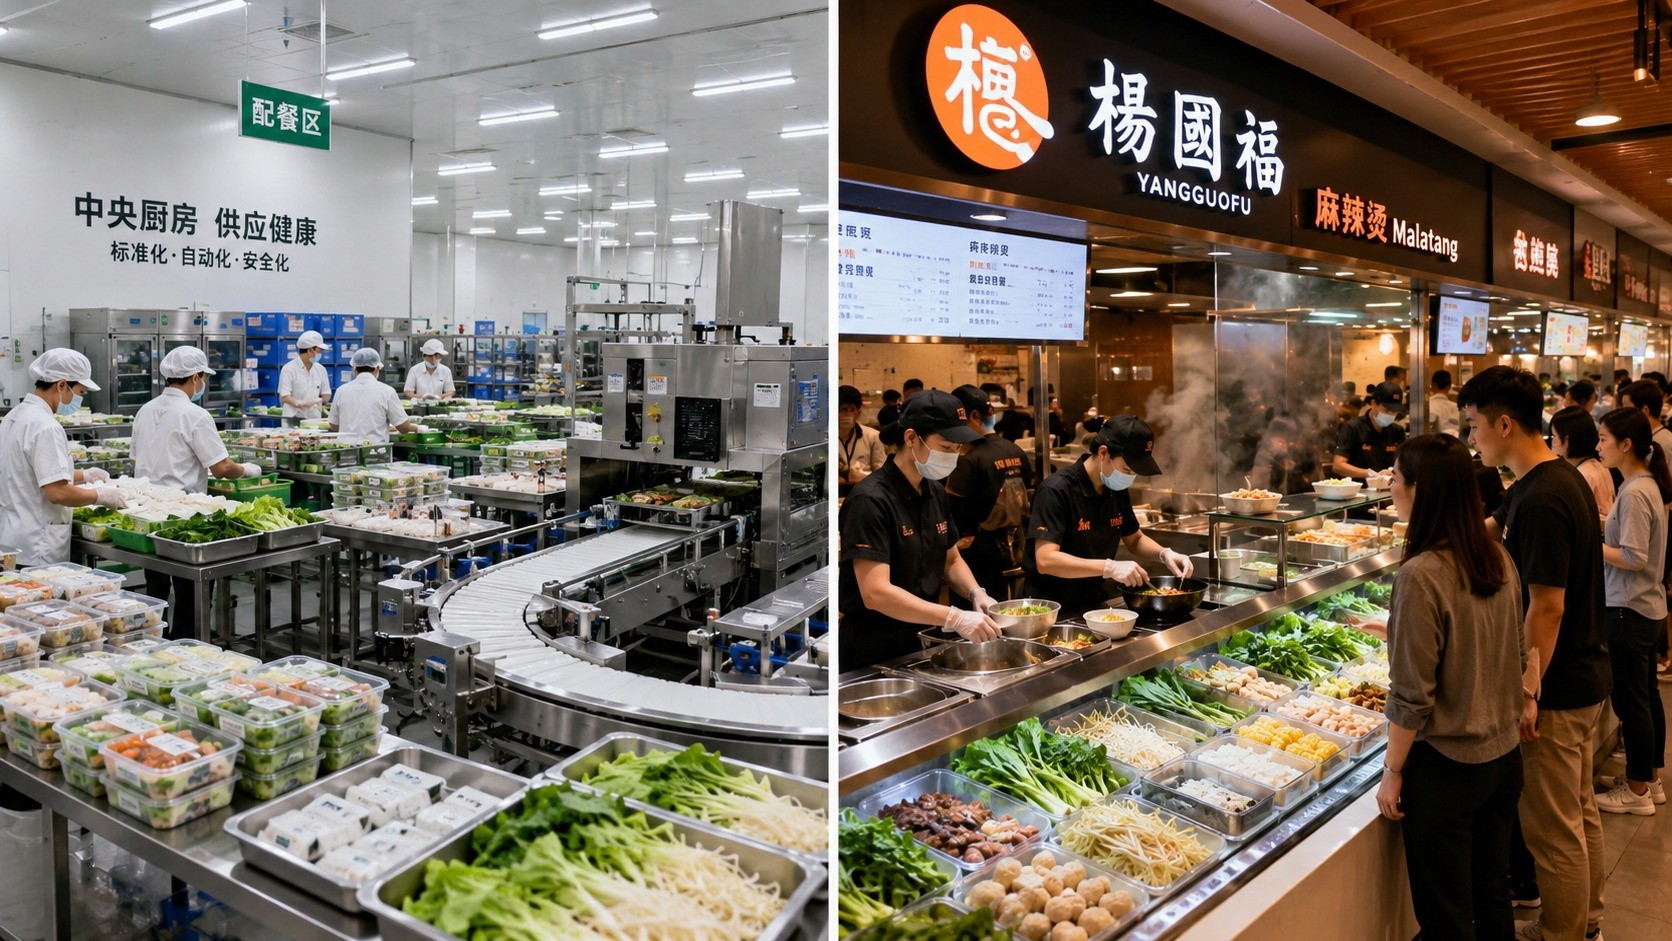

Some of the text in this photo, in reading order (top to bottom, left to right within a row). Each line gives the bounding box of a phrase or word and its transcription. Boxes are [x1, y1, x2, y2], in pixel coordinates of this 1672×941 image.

[252, 97, 322, 136] 配餐区
[1089, 59, 1284, 196] 楊國福
[75, 192, 317, 246] 中央厨房 供应健康
[1137, 171, 1252, 216] YANGGUOFU
[1315, 186, 1388, 243] 麻辣烫
[1393, 218, 1458, 263] Malatang
